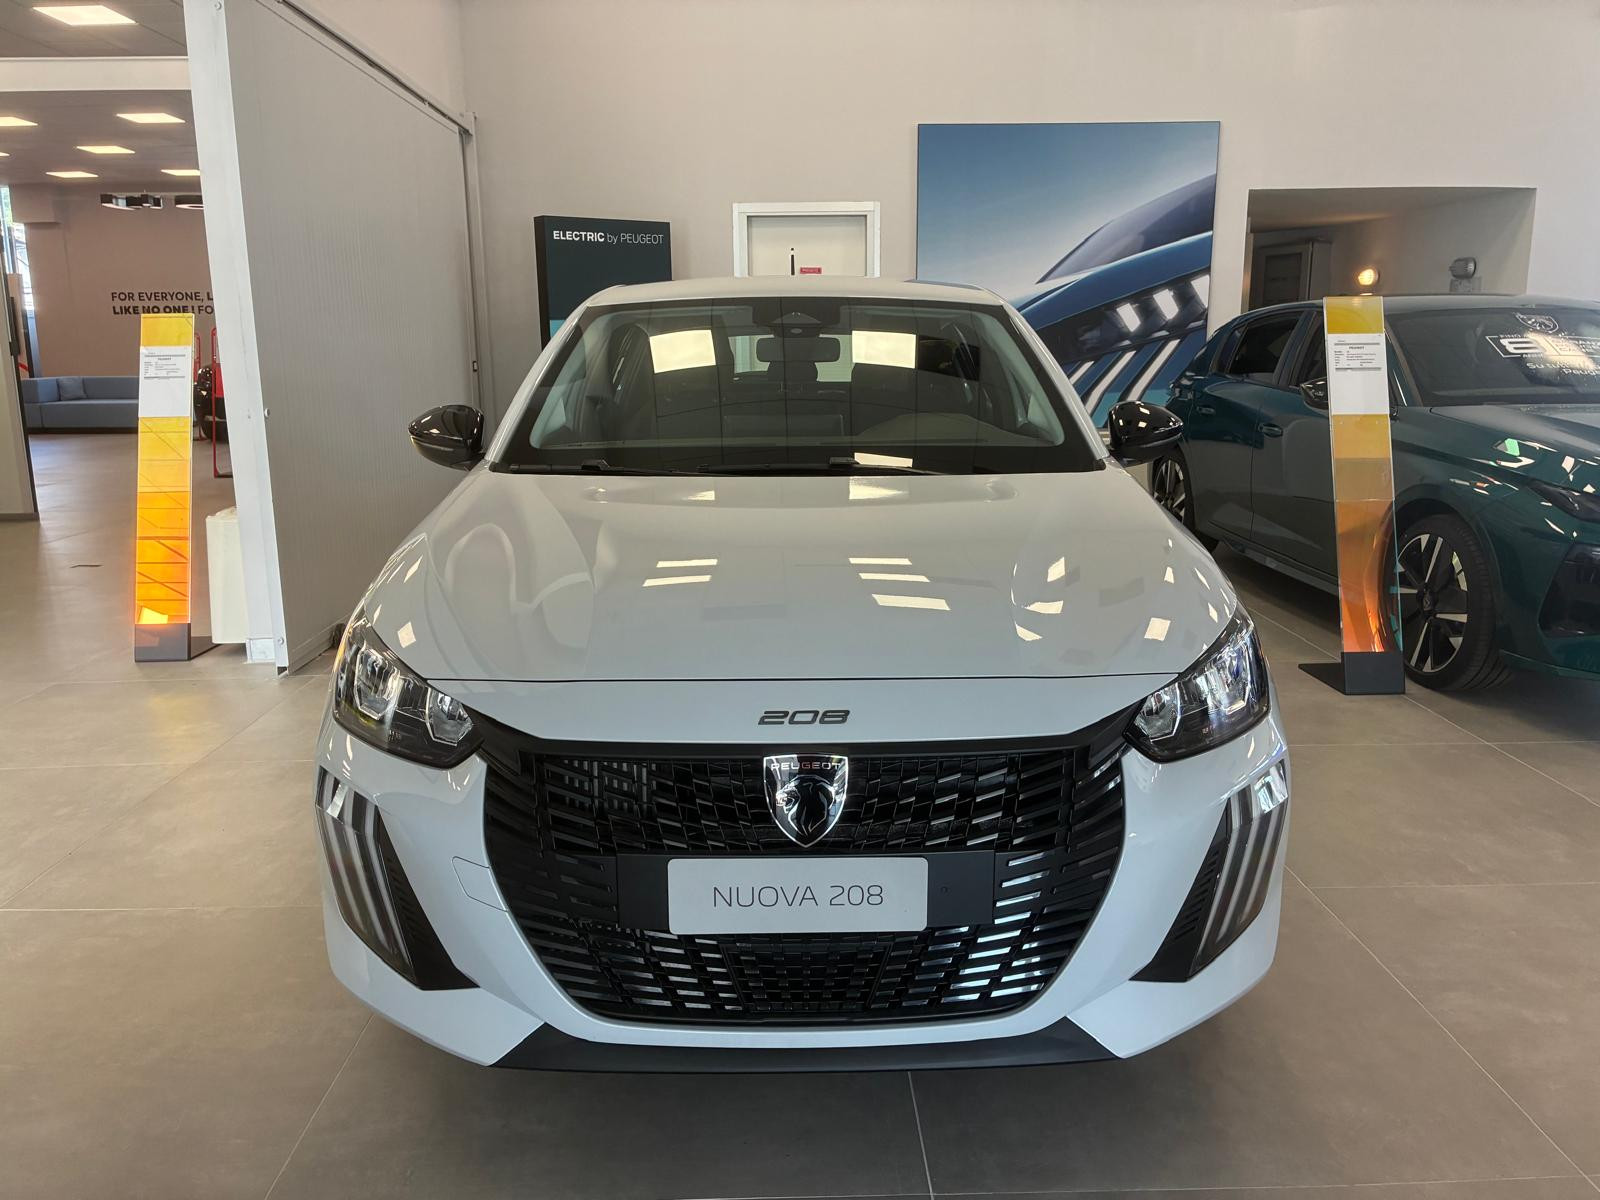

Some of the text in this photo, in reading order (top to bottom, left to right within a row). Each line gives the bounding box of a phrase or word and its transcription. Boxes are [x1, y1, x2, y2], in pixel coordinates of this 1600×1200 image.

[553, 230, 664, 244] ELECTRIC by PEUGEOT
[111, 291, 135, 302] FOR
[138, 291, 204, 302] EVERYONE,
[112, 305, 140, 315] LIKE
[142, 305, 160, 313] NO
[758, 709, 851, 726] 208
[770, 762, 841, 771] PEUGEOT
[713, 884, 884, 908] NUOVA 208
